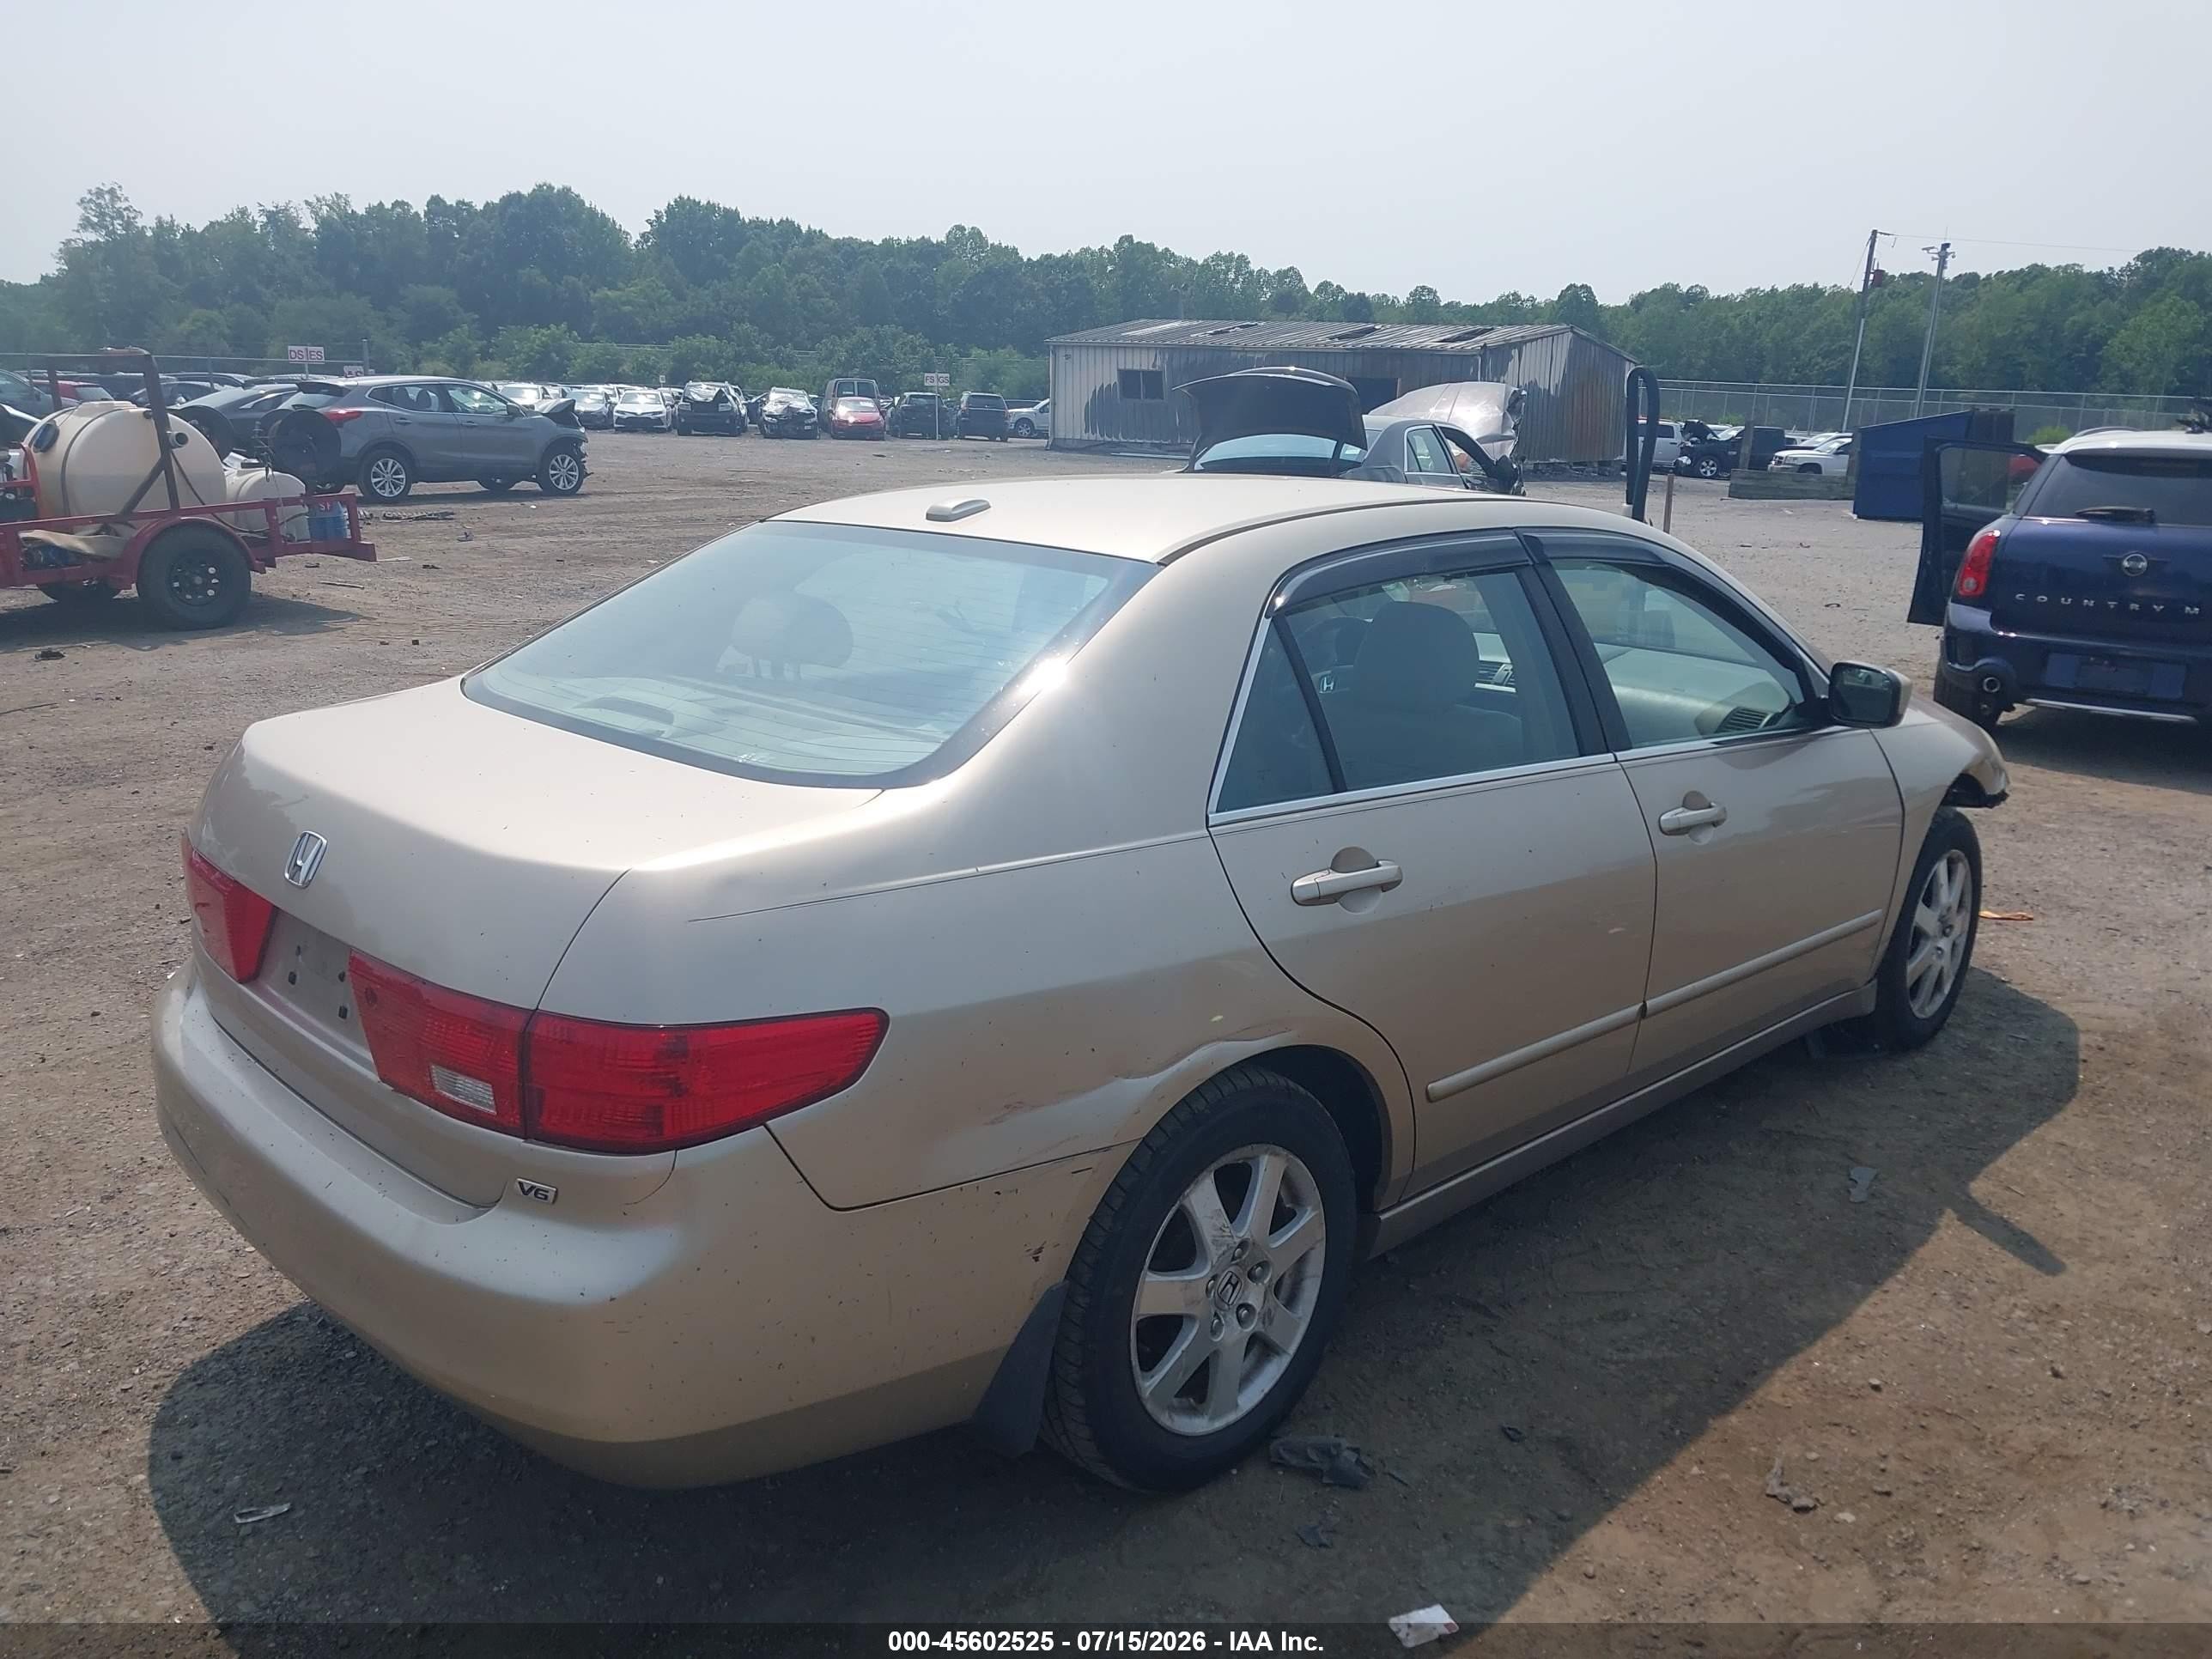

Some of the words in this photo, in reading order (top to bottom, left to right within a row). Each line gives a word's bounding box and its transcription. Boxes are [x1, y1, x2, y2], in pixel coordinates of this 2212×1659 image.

[289, 349, 304, 360] DS
[309, 350, 324, 361] ES
[925, 375, 935, 384] FS
[518, 1181, 550, 1200] V6
